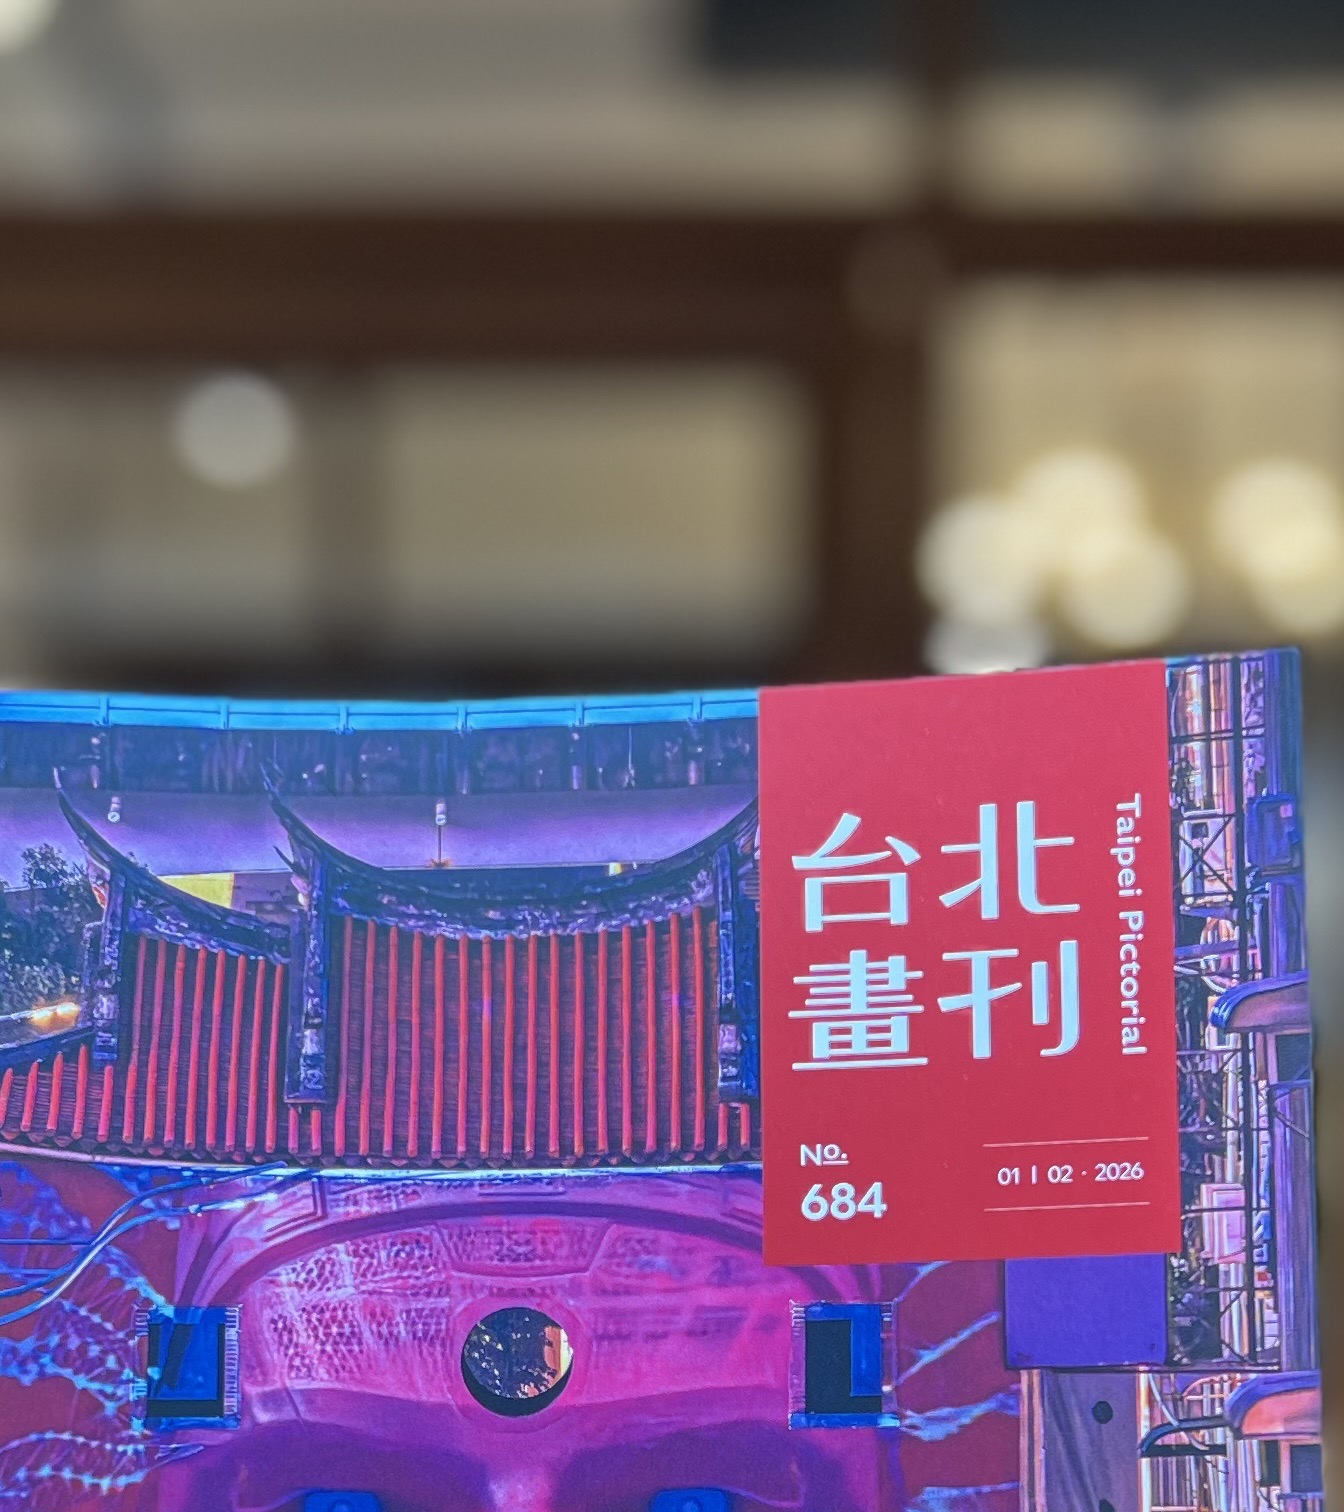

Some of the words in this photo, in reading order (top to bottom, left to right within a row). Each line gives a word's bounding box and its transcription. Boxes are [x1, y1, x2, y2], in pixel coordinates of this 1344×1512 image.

[791, 800, 1081, 932] 台北
[1109, 793, 1141, 898] Taipei
[788, 939, 1081, 1071] 畫刊
[1117, 909, 1148, 1056] Pictorial
[801, 1181, 888, 1221] 684
[997, 1167, 1020, 1186] 01
[1047, 1164, 1073, 1184] 02
[1094, 1161, 1145, 1182] 2026
